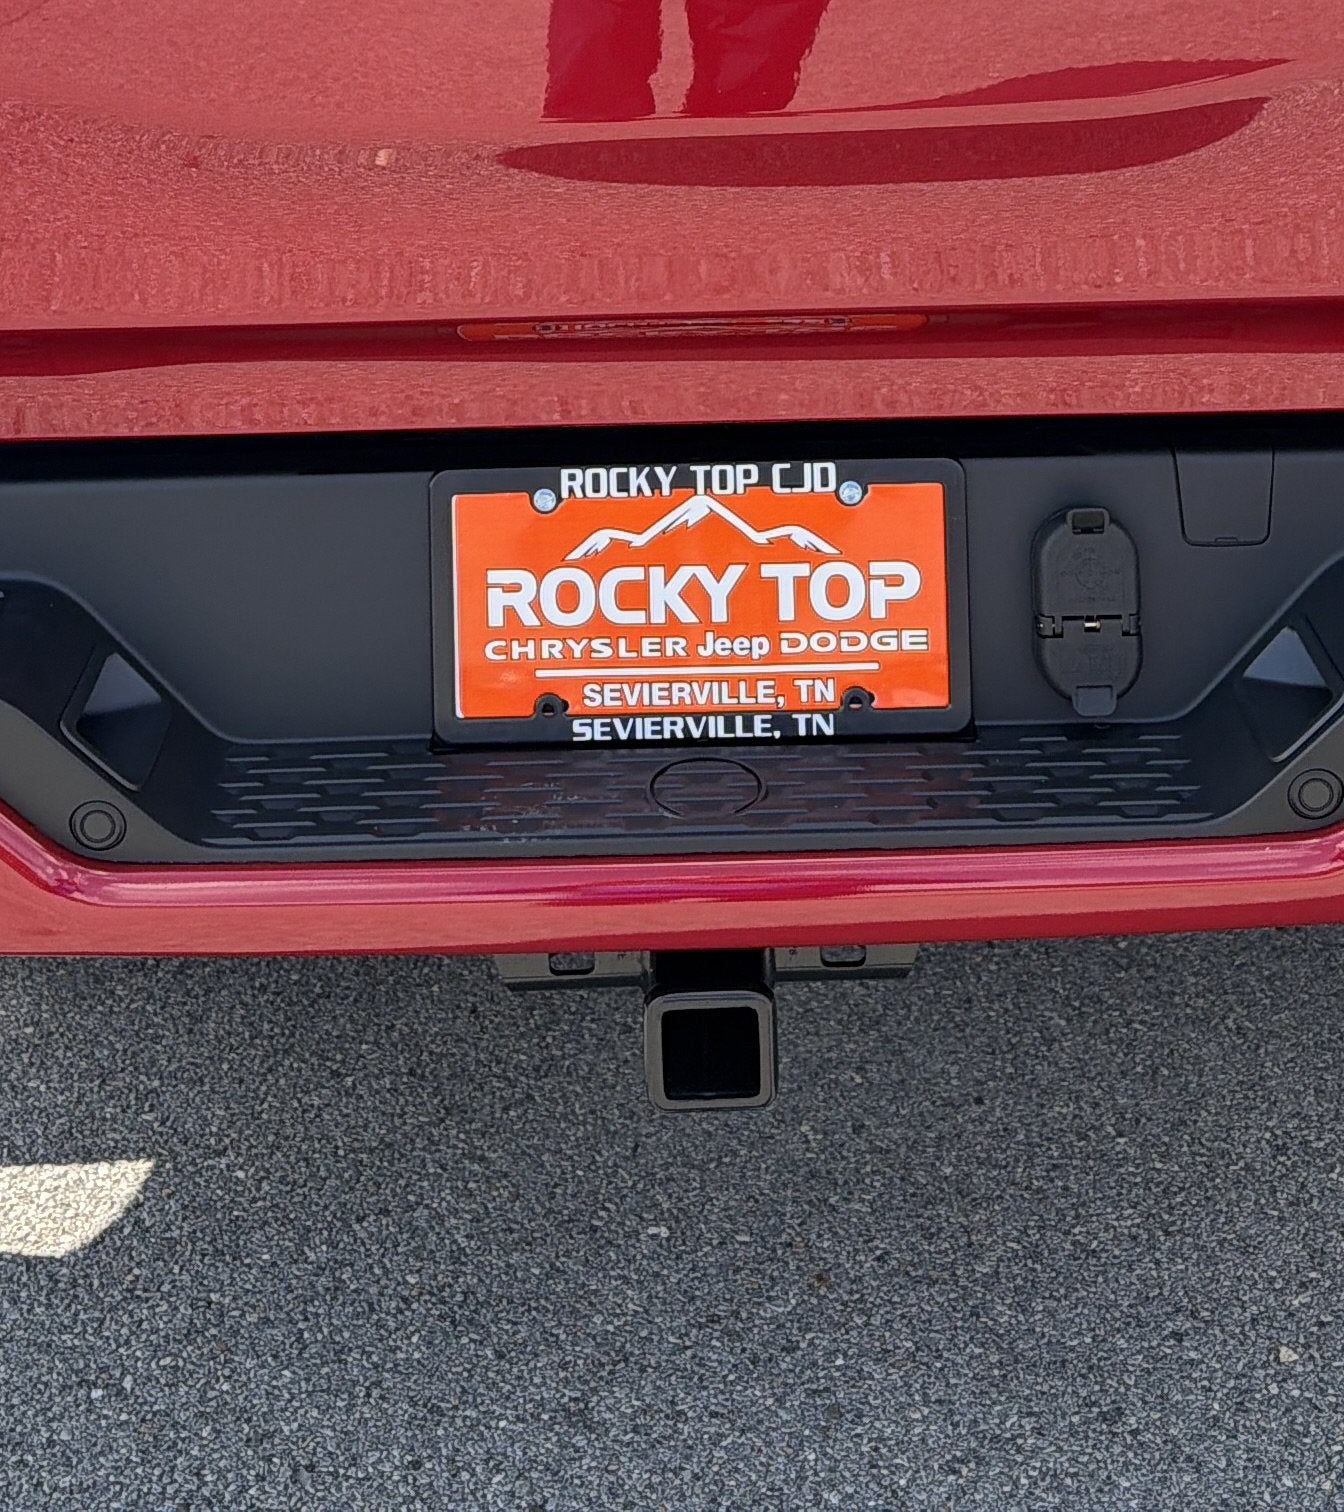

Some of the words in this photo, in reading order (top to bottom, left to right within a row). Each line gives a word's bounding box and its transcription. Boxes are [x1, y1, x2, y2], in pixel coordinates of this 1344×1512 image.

[560, 466, 677, 499] ROCKY
[690, 463, 759, 497] TOP
[772, 461, 837, 494] CJD
[485, 563, 749, 628] ROCKY
[760, 560, 922, 623] TOP
[484, 636, 689, 661] CHRYSLER
[697, 631, 770, 661] Jeep
[779, 629, 929, 654] DODGE
[582, 679, 786, 709] SEVIERVILLE,
[794, 678, 836, 704] TN
[572, 715, 781, 742] SEVIERVILLE,
[792, 713, 835, 737] TN
